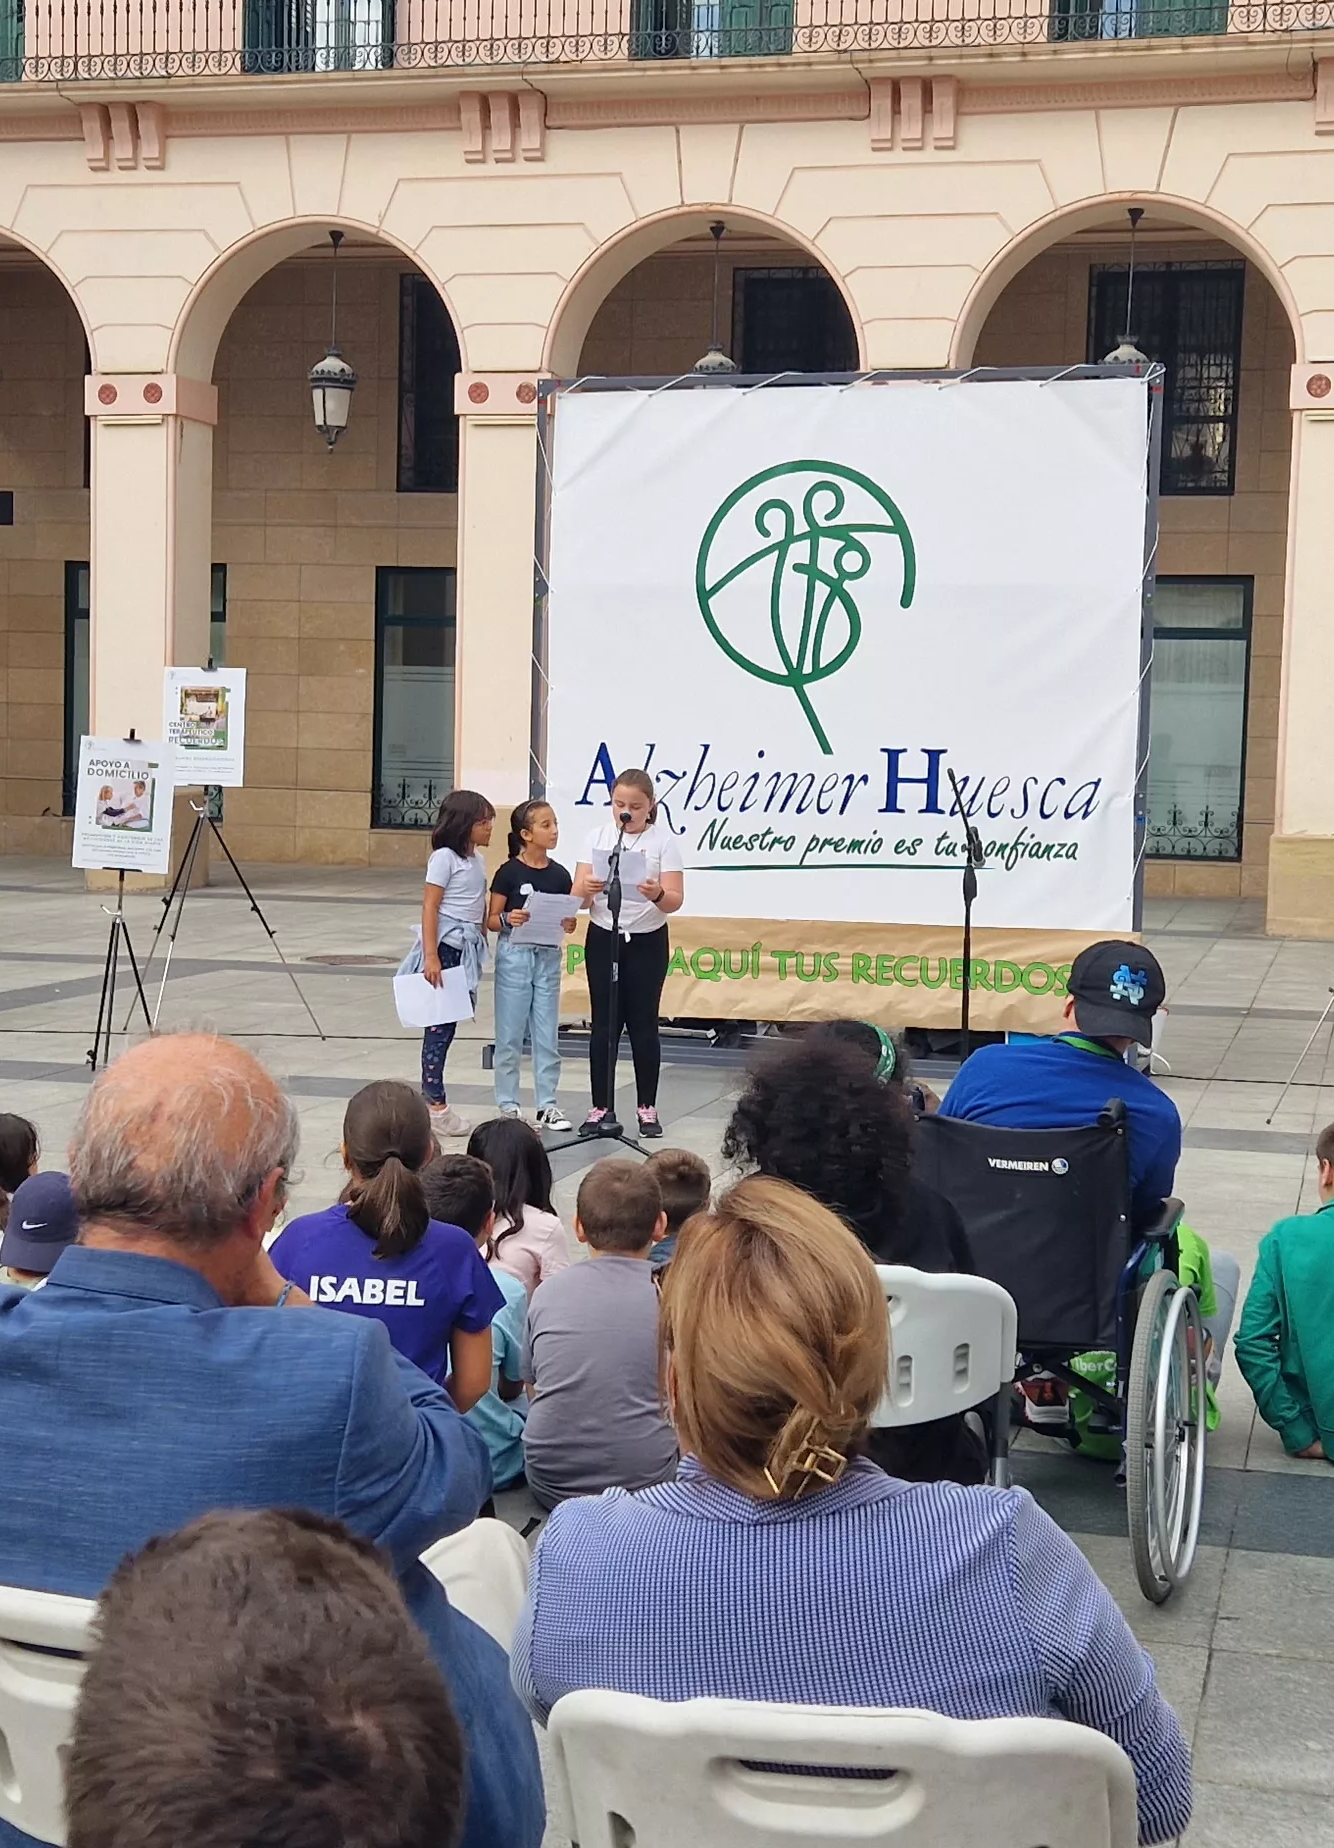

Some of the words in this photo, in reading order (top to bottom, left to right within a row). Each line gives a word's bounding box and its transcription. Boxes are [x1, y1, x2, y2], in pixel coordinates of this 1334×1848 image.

[87, 767, 149, 780] DOMICILIO
[89, 758, 122, 768] APOYO
[124, 761, 130, 769] A
[877, 748, 1103, 821] Huesca
[697, 817, 796, 852] Nuestro
[800, 829, 884, 866] premio
[894, 837, 924, 855] es
[934, 830, 958, 856] tu
[979, 826, 1079, 871] onfianza
[667, 941, 762, 983] AQUÍ
[770, 950, 840, 983] TUS
[852, 953, 1072, 997] RECUERDOS
[987, 1158, 1049, 1171] VERMEIREN
[309, 1275, 425, 1306] ISABEL
